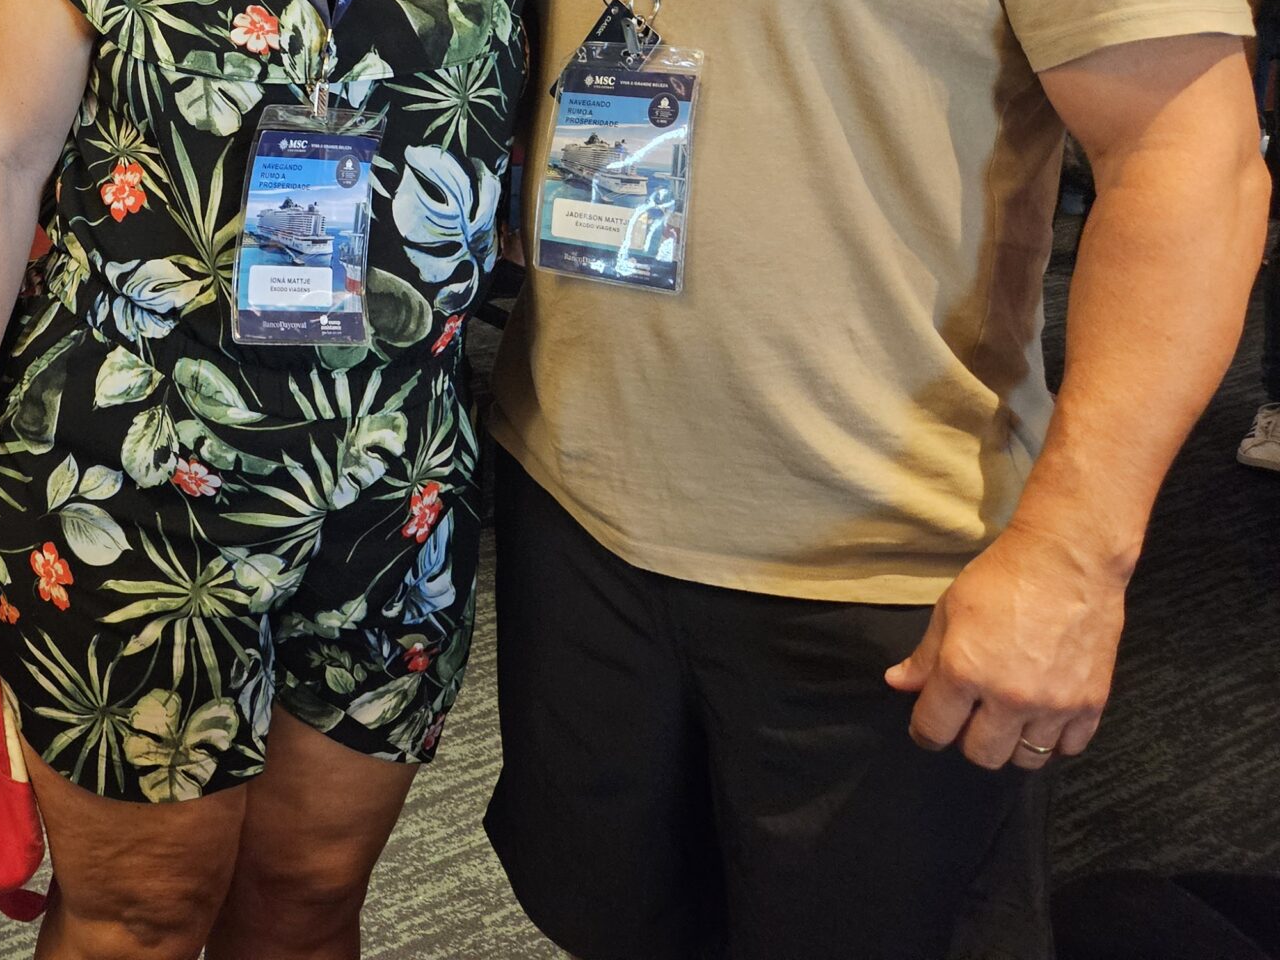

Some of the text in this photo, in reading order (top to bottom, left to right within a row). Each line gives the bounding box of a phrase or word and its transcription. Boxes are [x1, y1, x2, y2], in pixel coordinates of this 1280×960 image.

[594, 75, 616, 86] MSC
[568, 98, 611, 108] NAVEGANDO
[567, 107, 586, 115] RUMO
[565, 117, 619, 128] PROSPERIDADE
[288, 139, 308, 149] MSC
[262, 162, 303, 171] NAVEGANDO
[260, 171, 281, 179] RUMO
[259, 181, 311, 191] PROSPERIDADE
[604, 216, 629, 226] MATTJ
[287, 277, 311, 285] MATTJE
